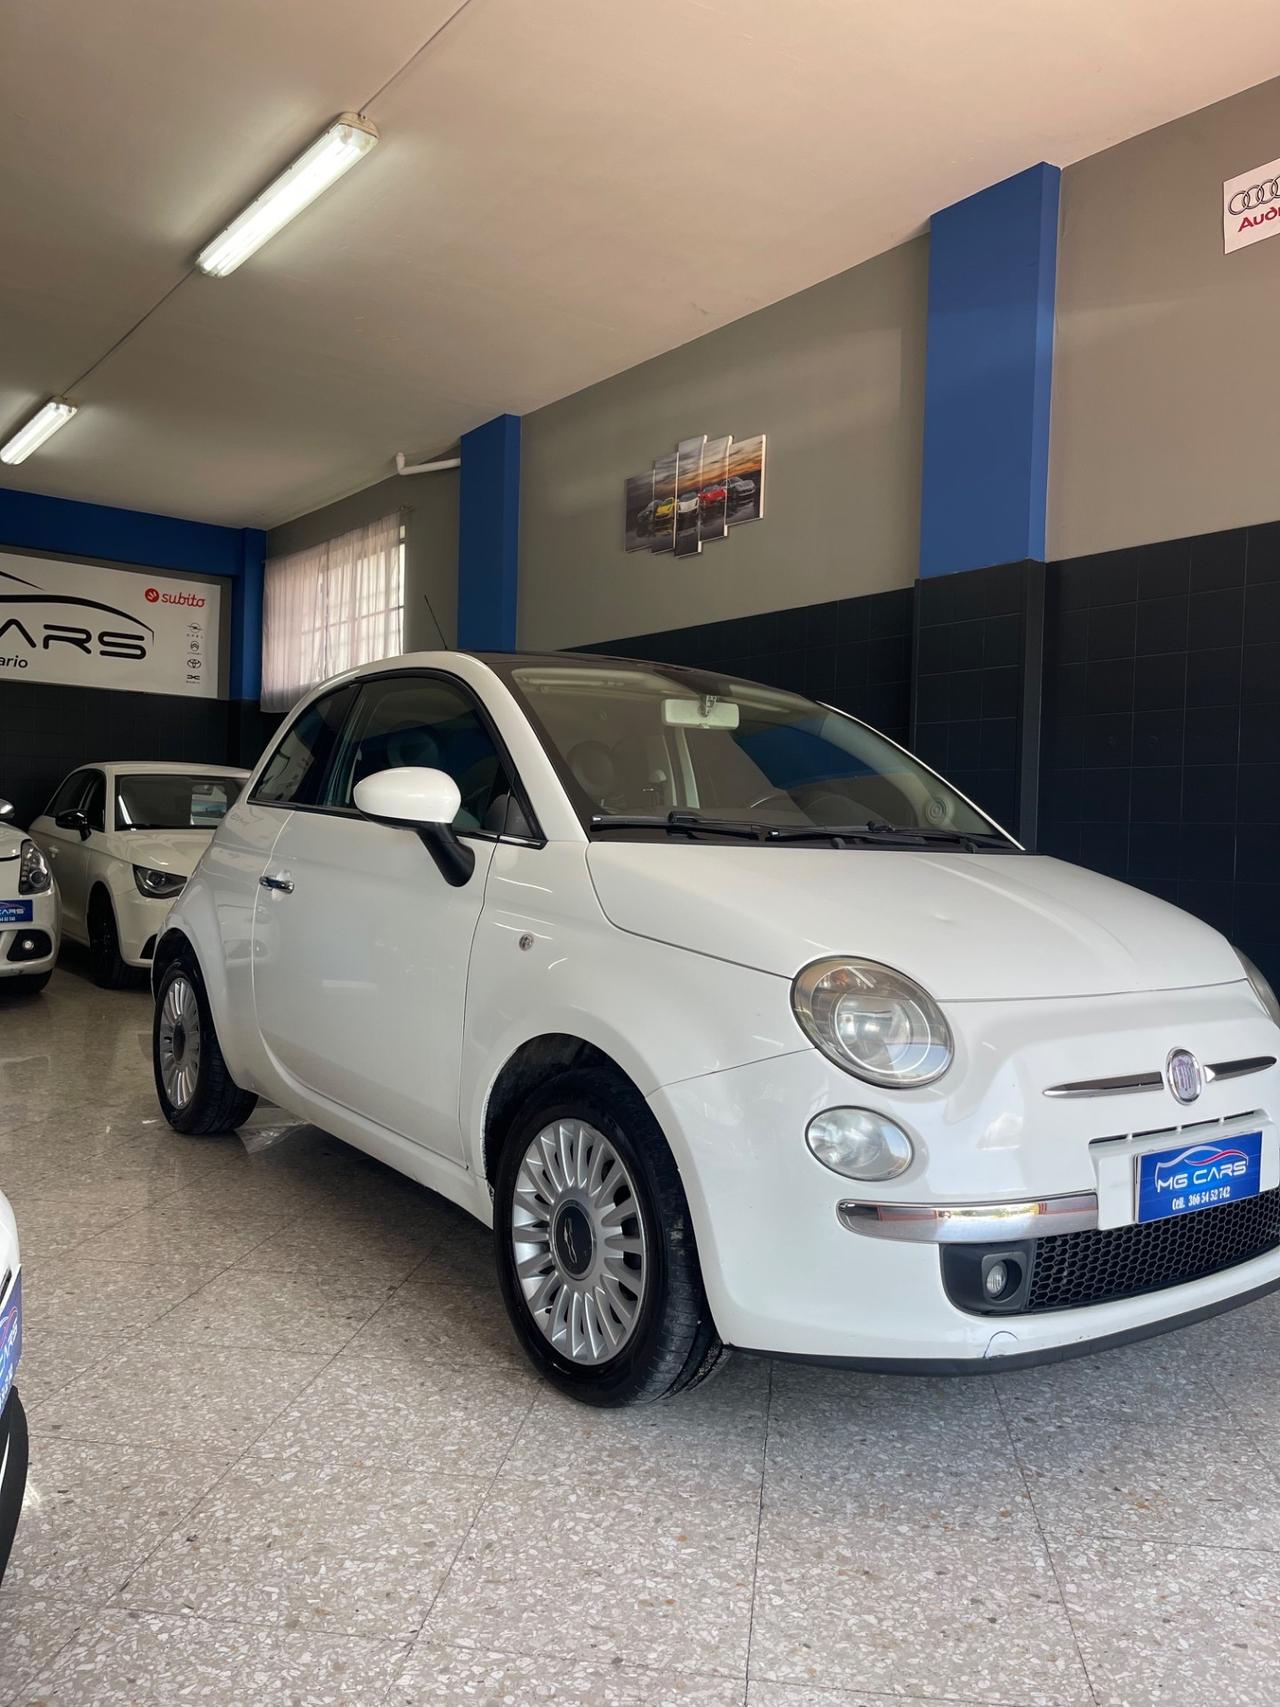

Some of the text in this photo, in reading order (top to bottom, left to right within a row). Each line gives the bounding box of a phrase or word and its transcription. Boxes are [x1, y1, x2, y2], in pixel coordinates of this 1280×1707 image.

[161, 592, 205, 607] subito
[1157, 1160, 1247, 1193] MG CARS
